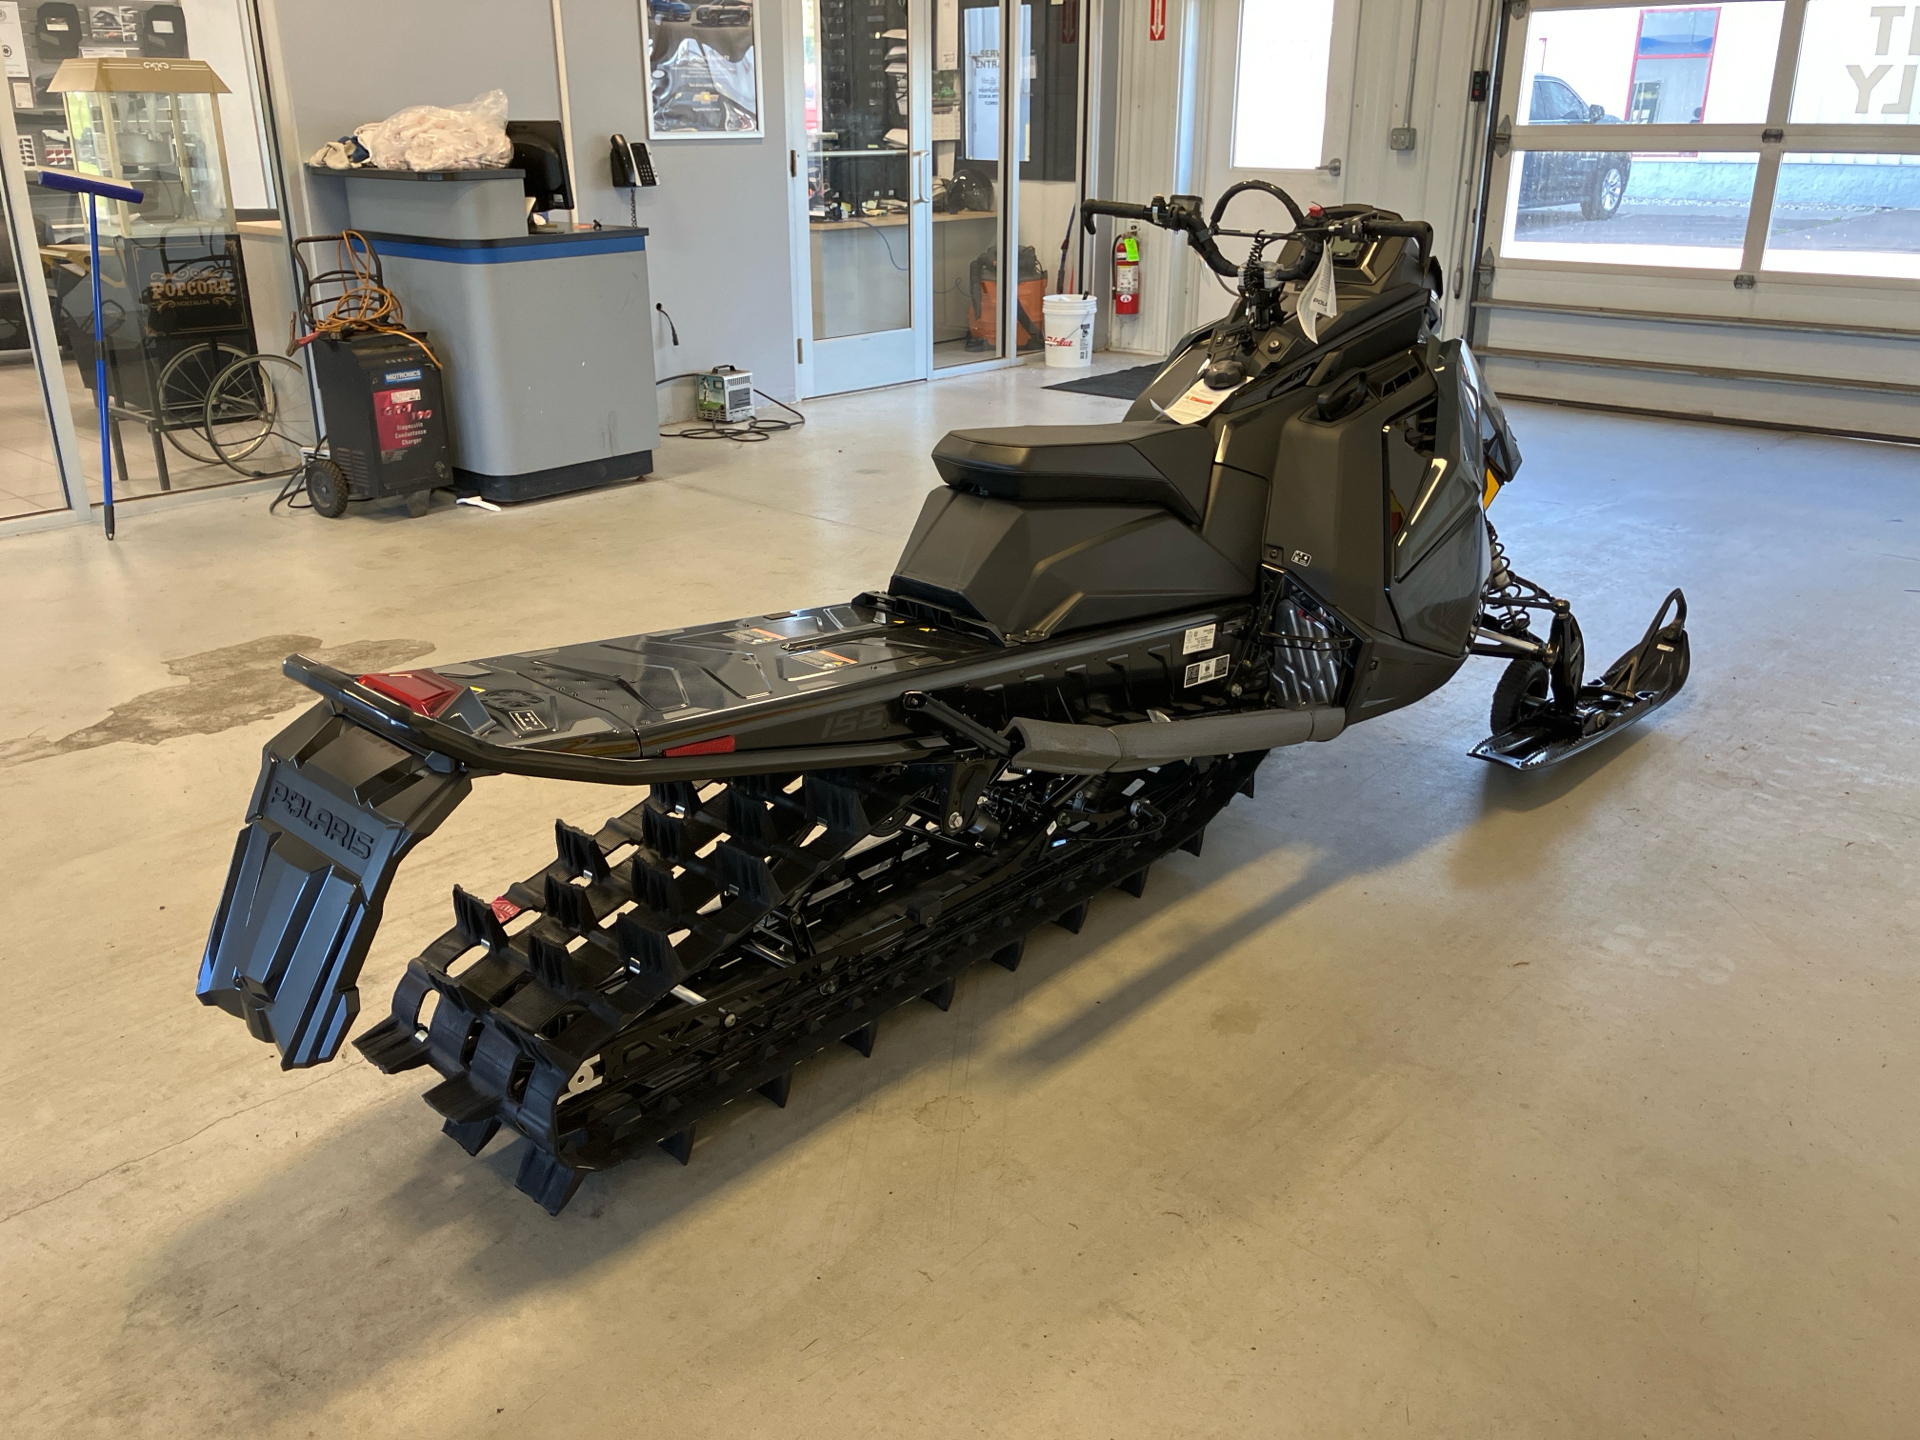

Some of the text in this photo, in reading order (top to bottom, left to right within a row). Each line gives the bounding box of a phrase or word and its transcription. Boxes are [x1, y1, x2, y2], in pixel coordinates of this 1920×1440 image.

[150, 277, 231, 300] POPCORN
[821, 708, 885, 739] 155
[271, 780, 375, 860] POLARIS
